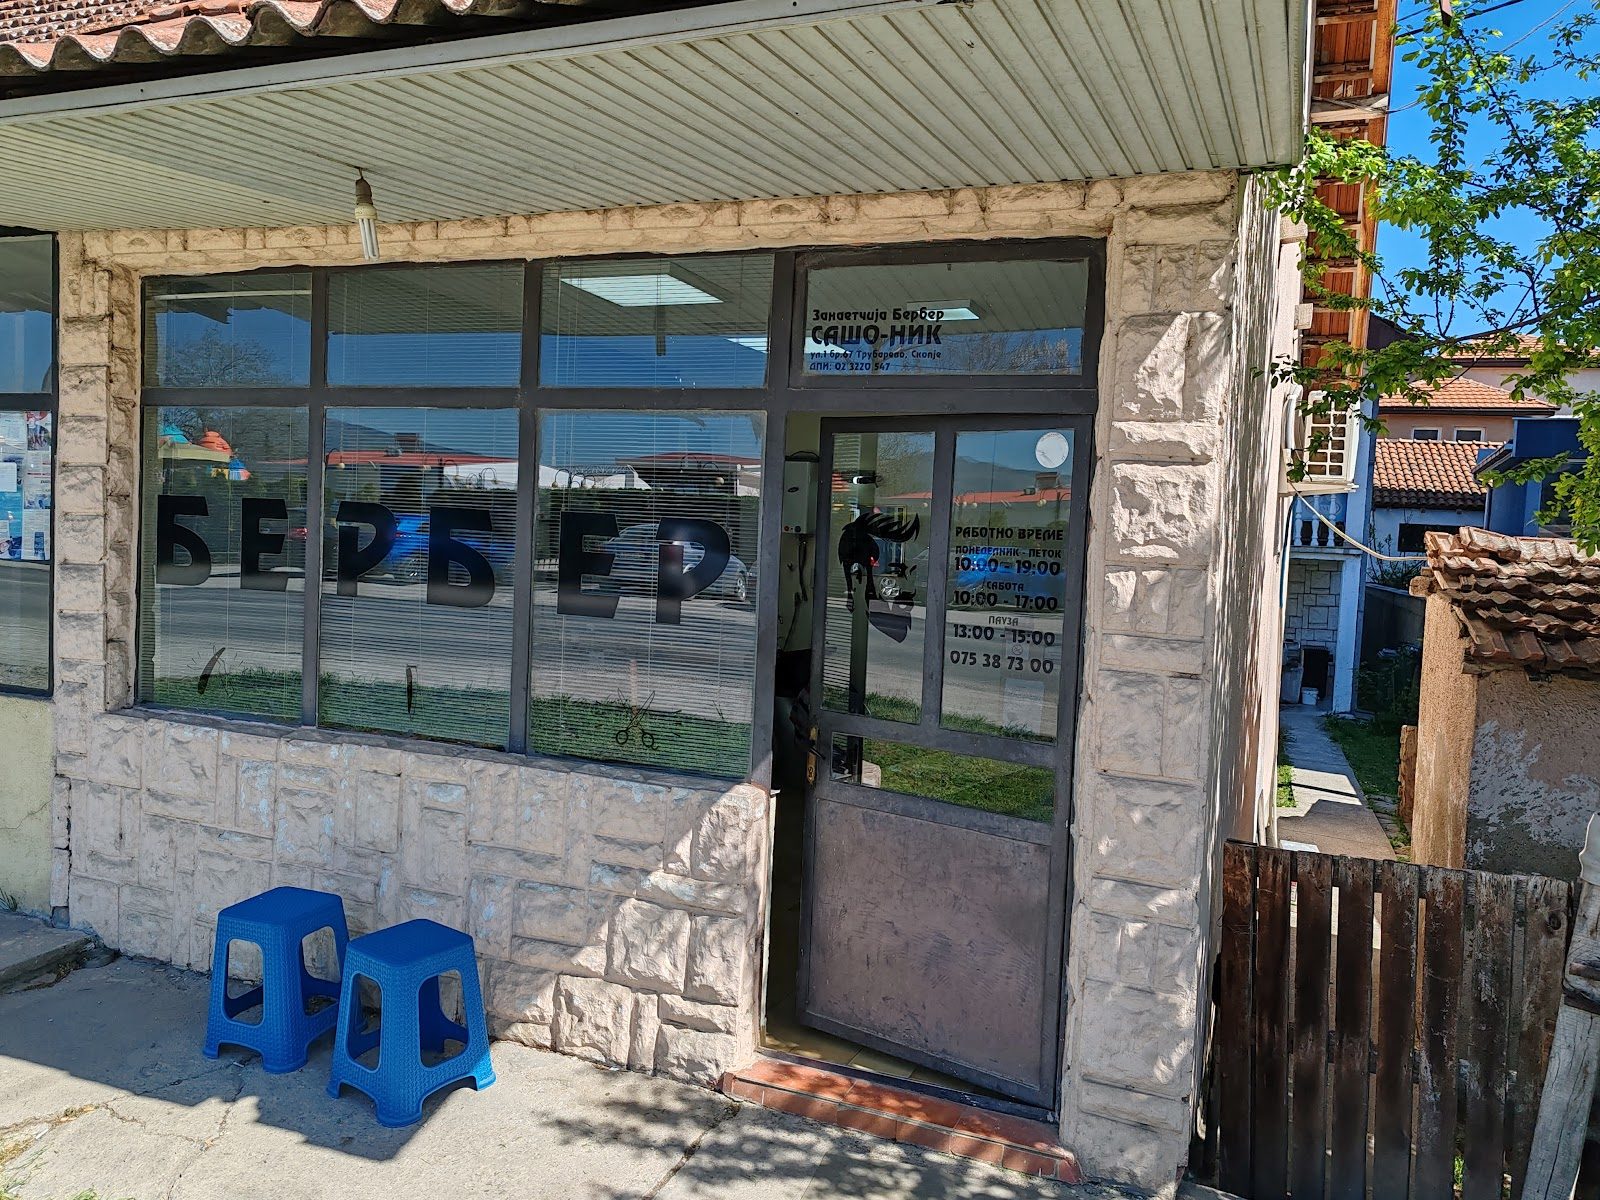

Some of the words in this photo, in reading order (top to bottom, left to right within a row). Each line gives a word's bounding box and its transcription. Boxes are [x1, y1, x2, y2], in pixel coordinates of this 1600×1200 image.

[812, 309, 887, 323] Занаетчија
[892, 307, 944, 322] Бербер
[811, 324, 943, 346] САШО-НИК
[911, 350, 942, 360] Скопје
[835, 362, 846, 371] 02
[955, 526, 1014, 540] РАБОТНО
[1018, 528, 1064, 541] ВРЕМЕ
[955, 545, 1020, 557] ПОНЕДЕЛНИК
[1028, 549, 1062, 559] ПЕТОК
[954, 557, 999, 573] 10:00
[1015, 560, 1061, 576] 19:00
[986, 581, 1024, 592] САБОТА
[954, 590, 998, 607] 10:00
[1014, 595, 1058, 611] 17:00
[988, 615, 1019, 626] ПАУЗА
[954, 624, 995, 640] 13:00
[1012, 629, 1056, 646] 15:00
[950, 650, 977, 666] 075
[982, 653, 1001, 668] 38
[1007, 656, 1024, 671] 73
[1030, 658, 1054, 674] 00
